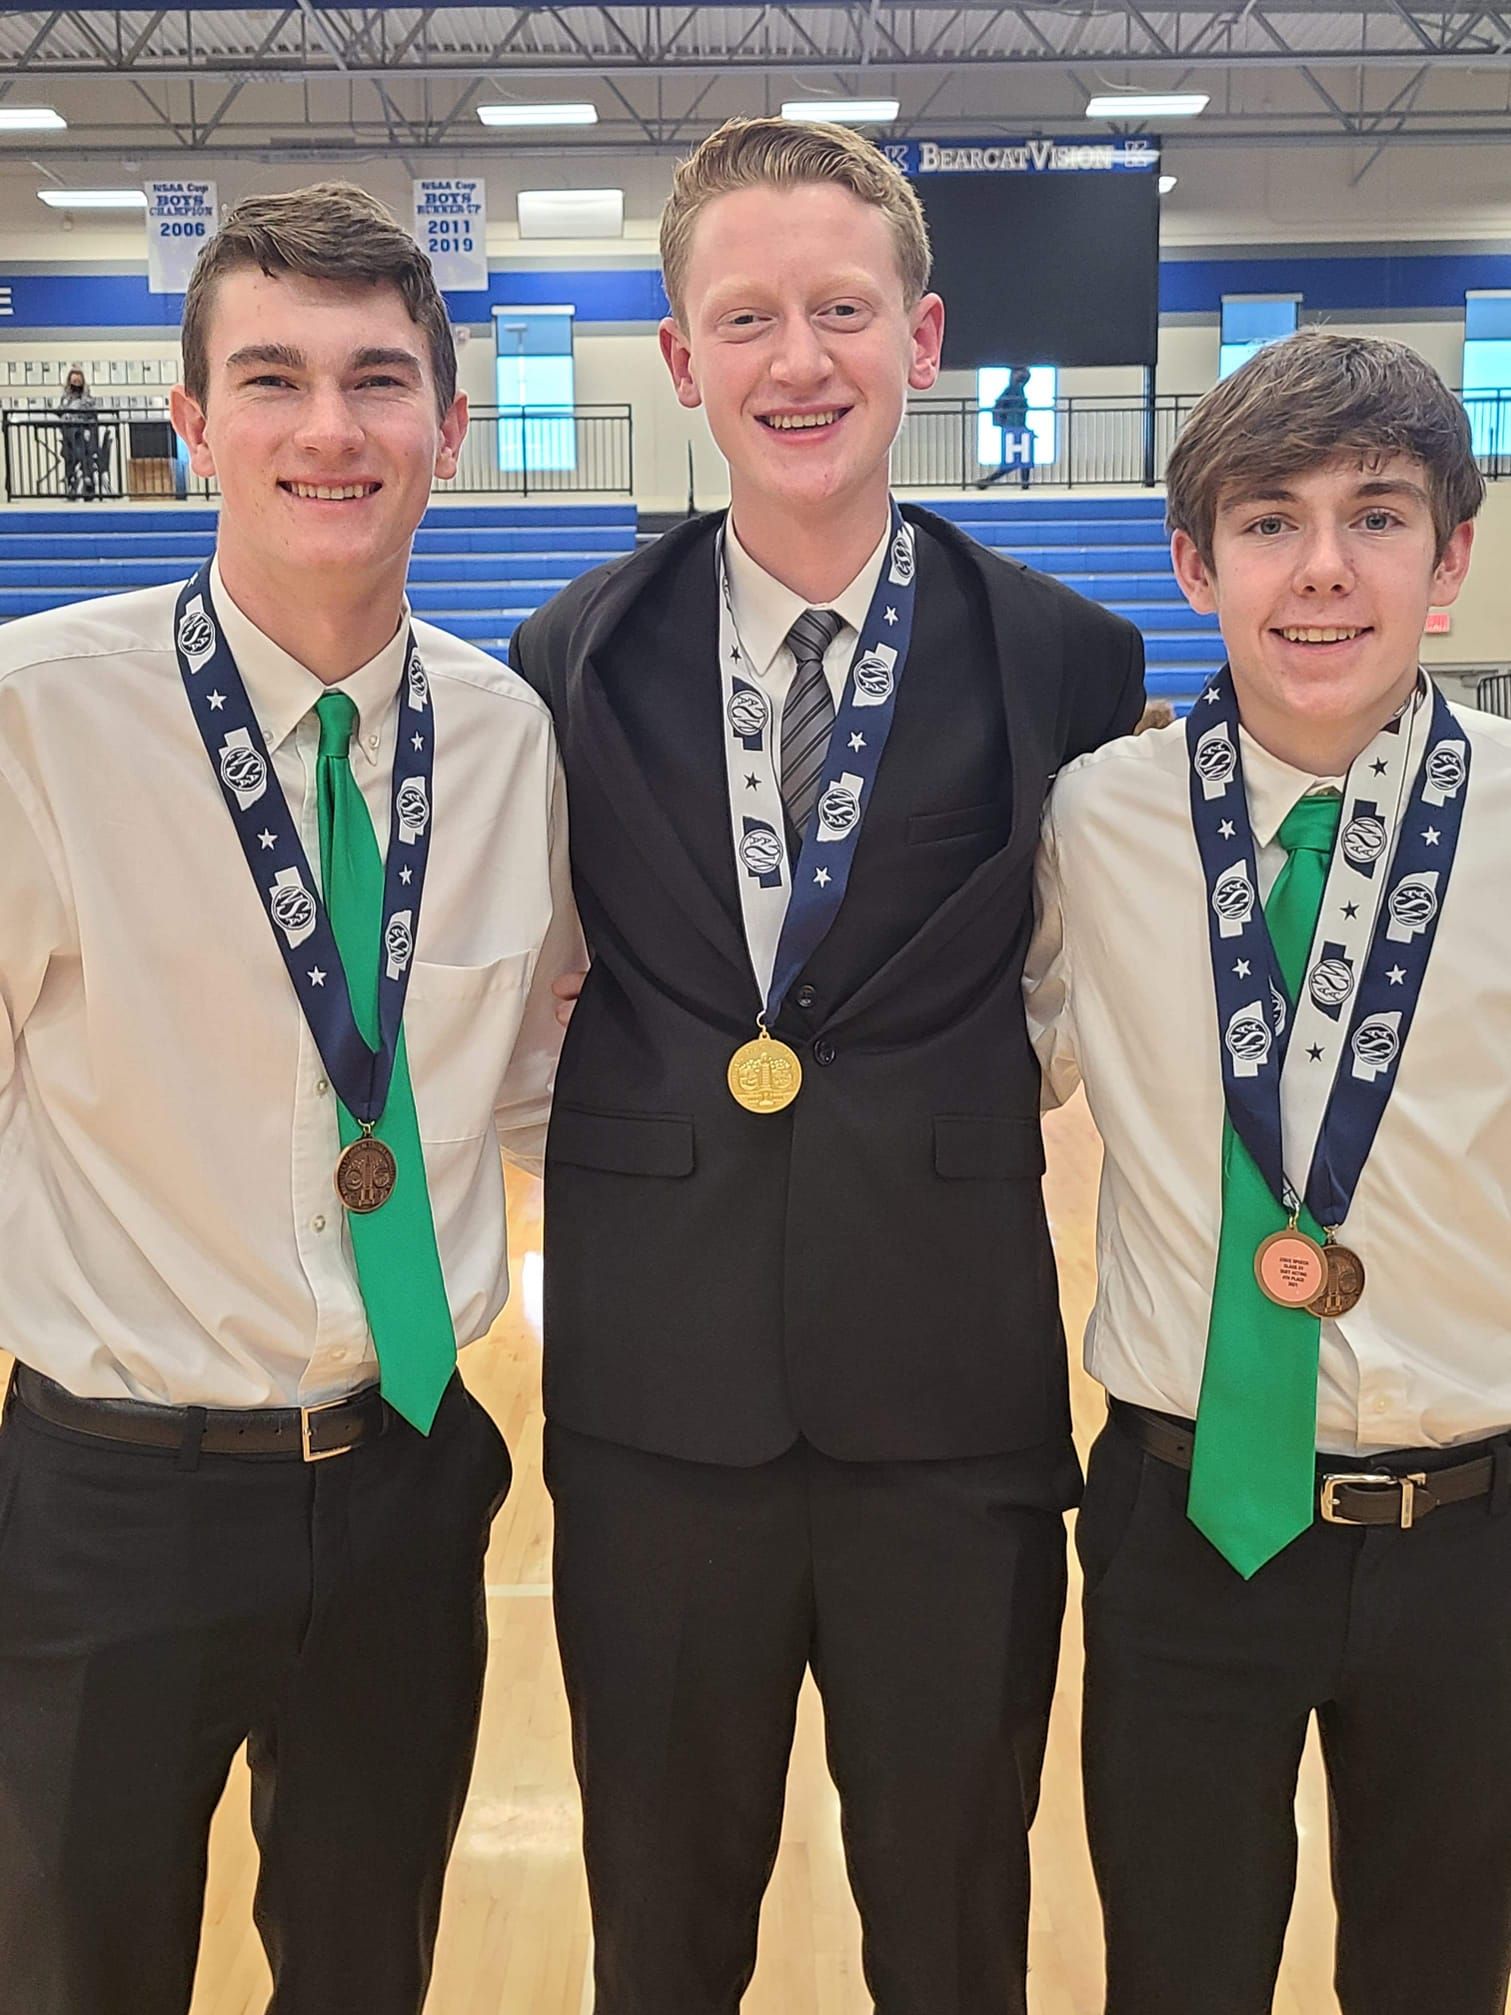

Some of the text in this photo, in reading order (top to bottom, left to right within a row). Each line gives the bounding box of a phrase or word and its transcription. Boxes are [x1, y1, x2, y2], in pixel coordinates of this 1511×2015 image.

[187, 183, 209, 194] Cup
[455, 181, 477, 191] Cup
[156, 195, 204, 206] BOYS
[425, 193, 472, 204] BOYS
[149, 207, 213, 216] CHAMPION
[160, 222, 206, 237] 2006
[428, 220, 470, 234] 2011
[428, 238, 473, 252] 2019
[1005, 432, 1031, 464] H
